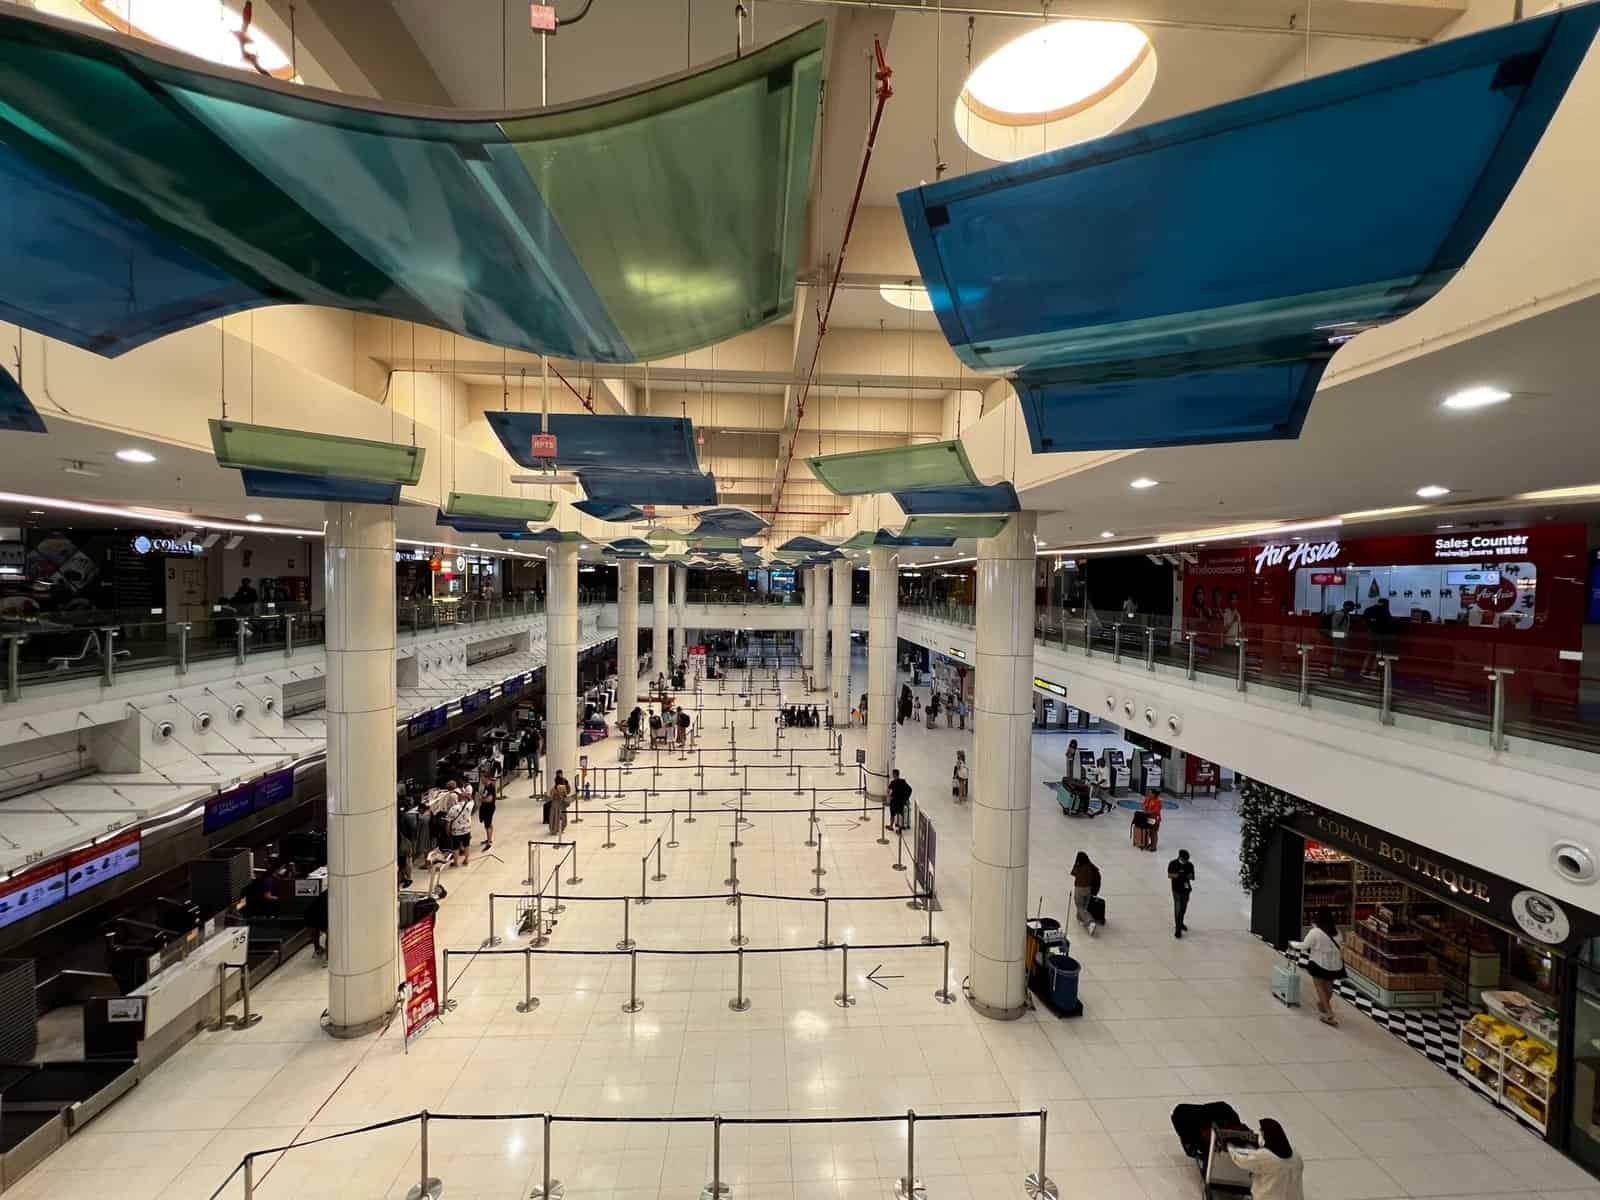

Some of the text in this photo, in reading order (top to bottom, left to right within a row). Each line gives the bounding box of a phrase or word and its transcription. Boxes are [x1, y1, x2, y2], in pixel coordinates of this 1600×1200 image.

[1255, 541, 1340, 575] Air Asia
[1435, 535, 1529, 549] Sales Counter
[1317, 816, 1490, 903] CORAL BOUTIQUE
